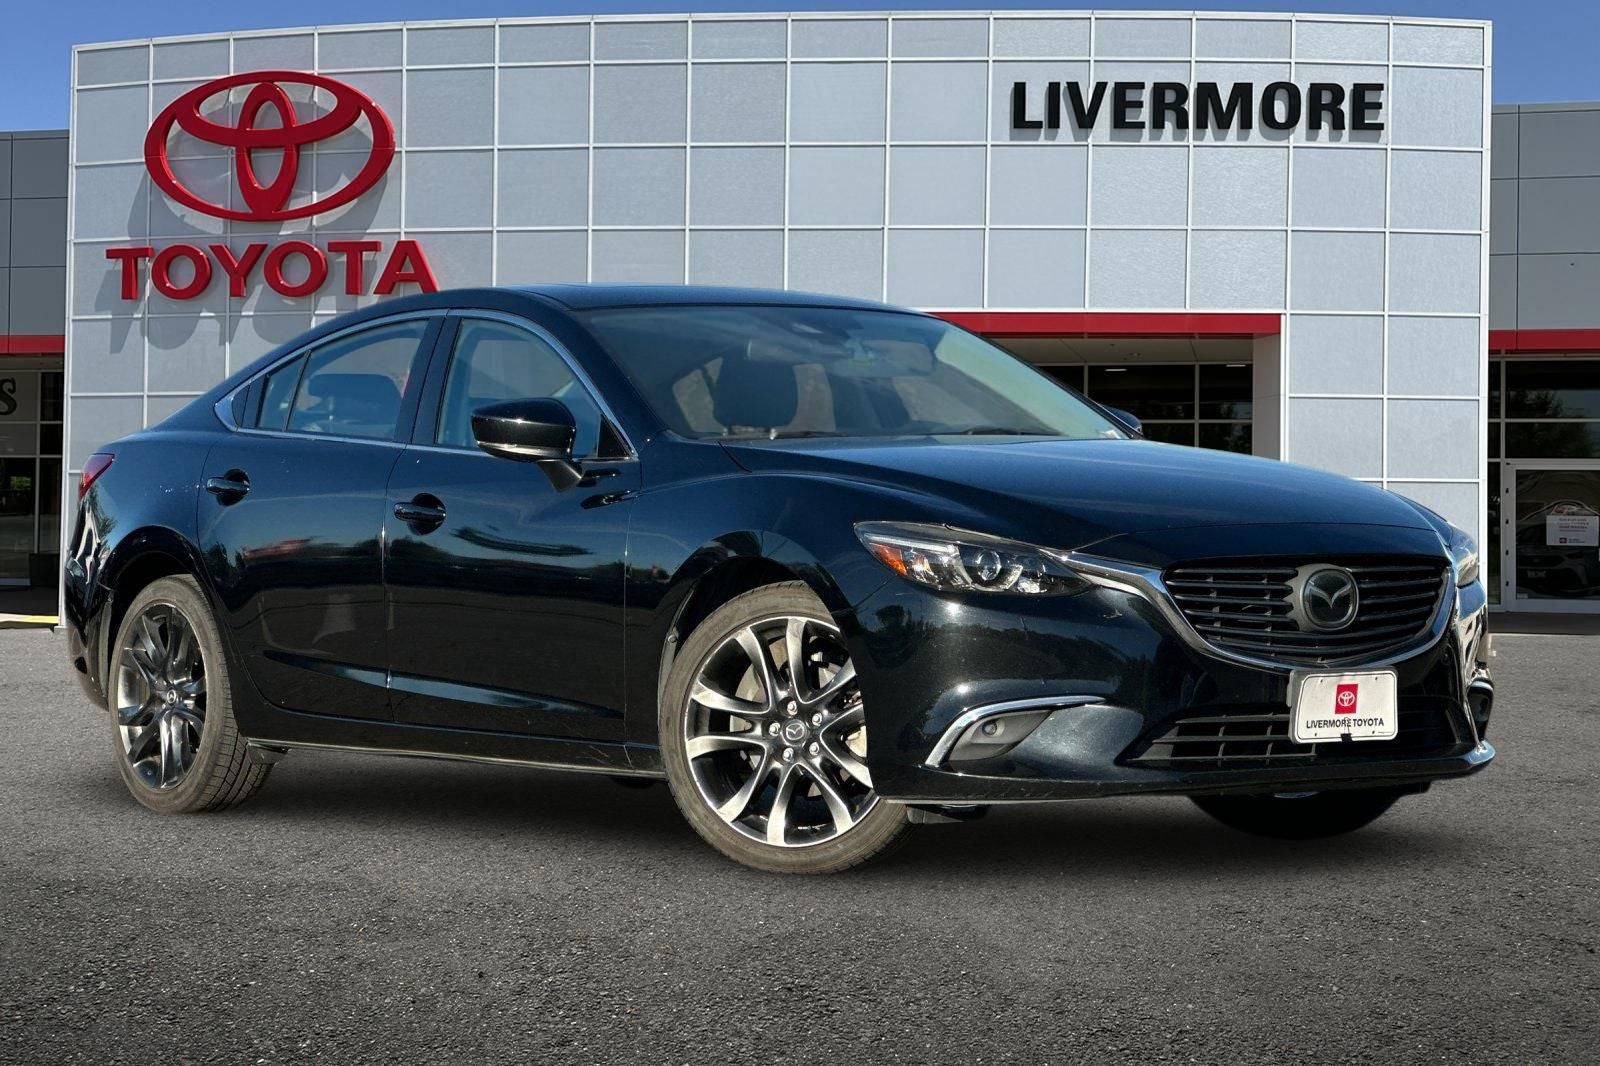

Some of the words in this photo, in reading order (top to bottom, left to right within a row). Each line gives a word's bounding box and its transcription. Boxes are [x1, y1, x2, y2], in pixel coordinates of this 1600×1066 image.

[1012, 81, 1385, 131] LIVERMORE
[105, 239, 438, 300] TOYOTA
[1306, 718, 1351, 729] LIVERMORE
[1352, 717, 1384, 728] TOYOTA
